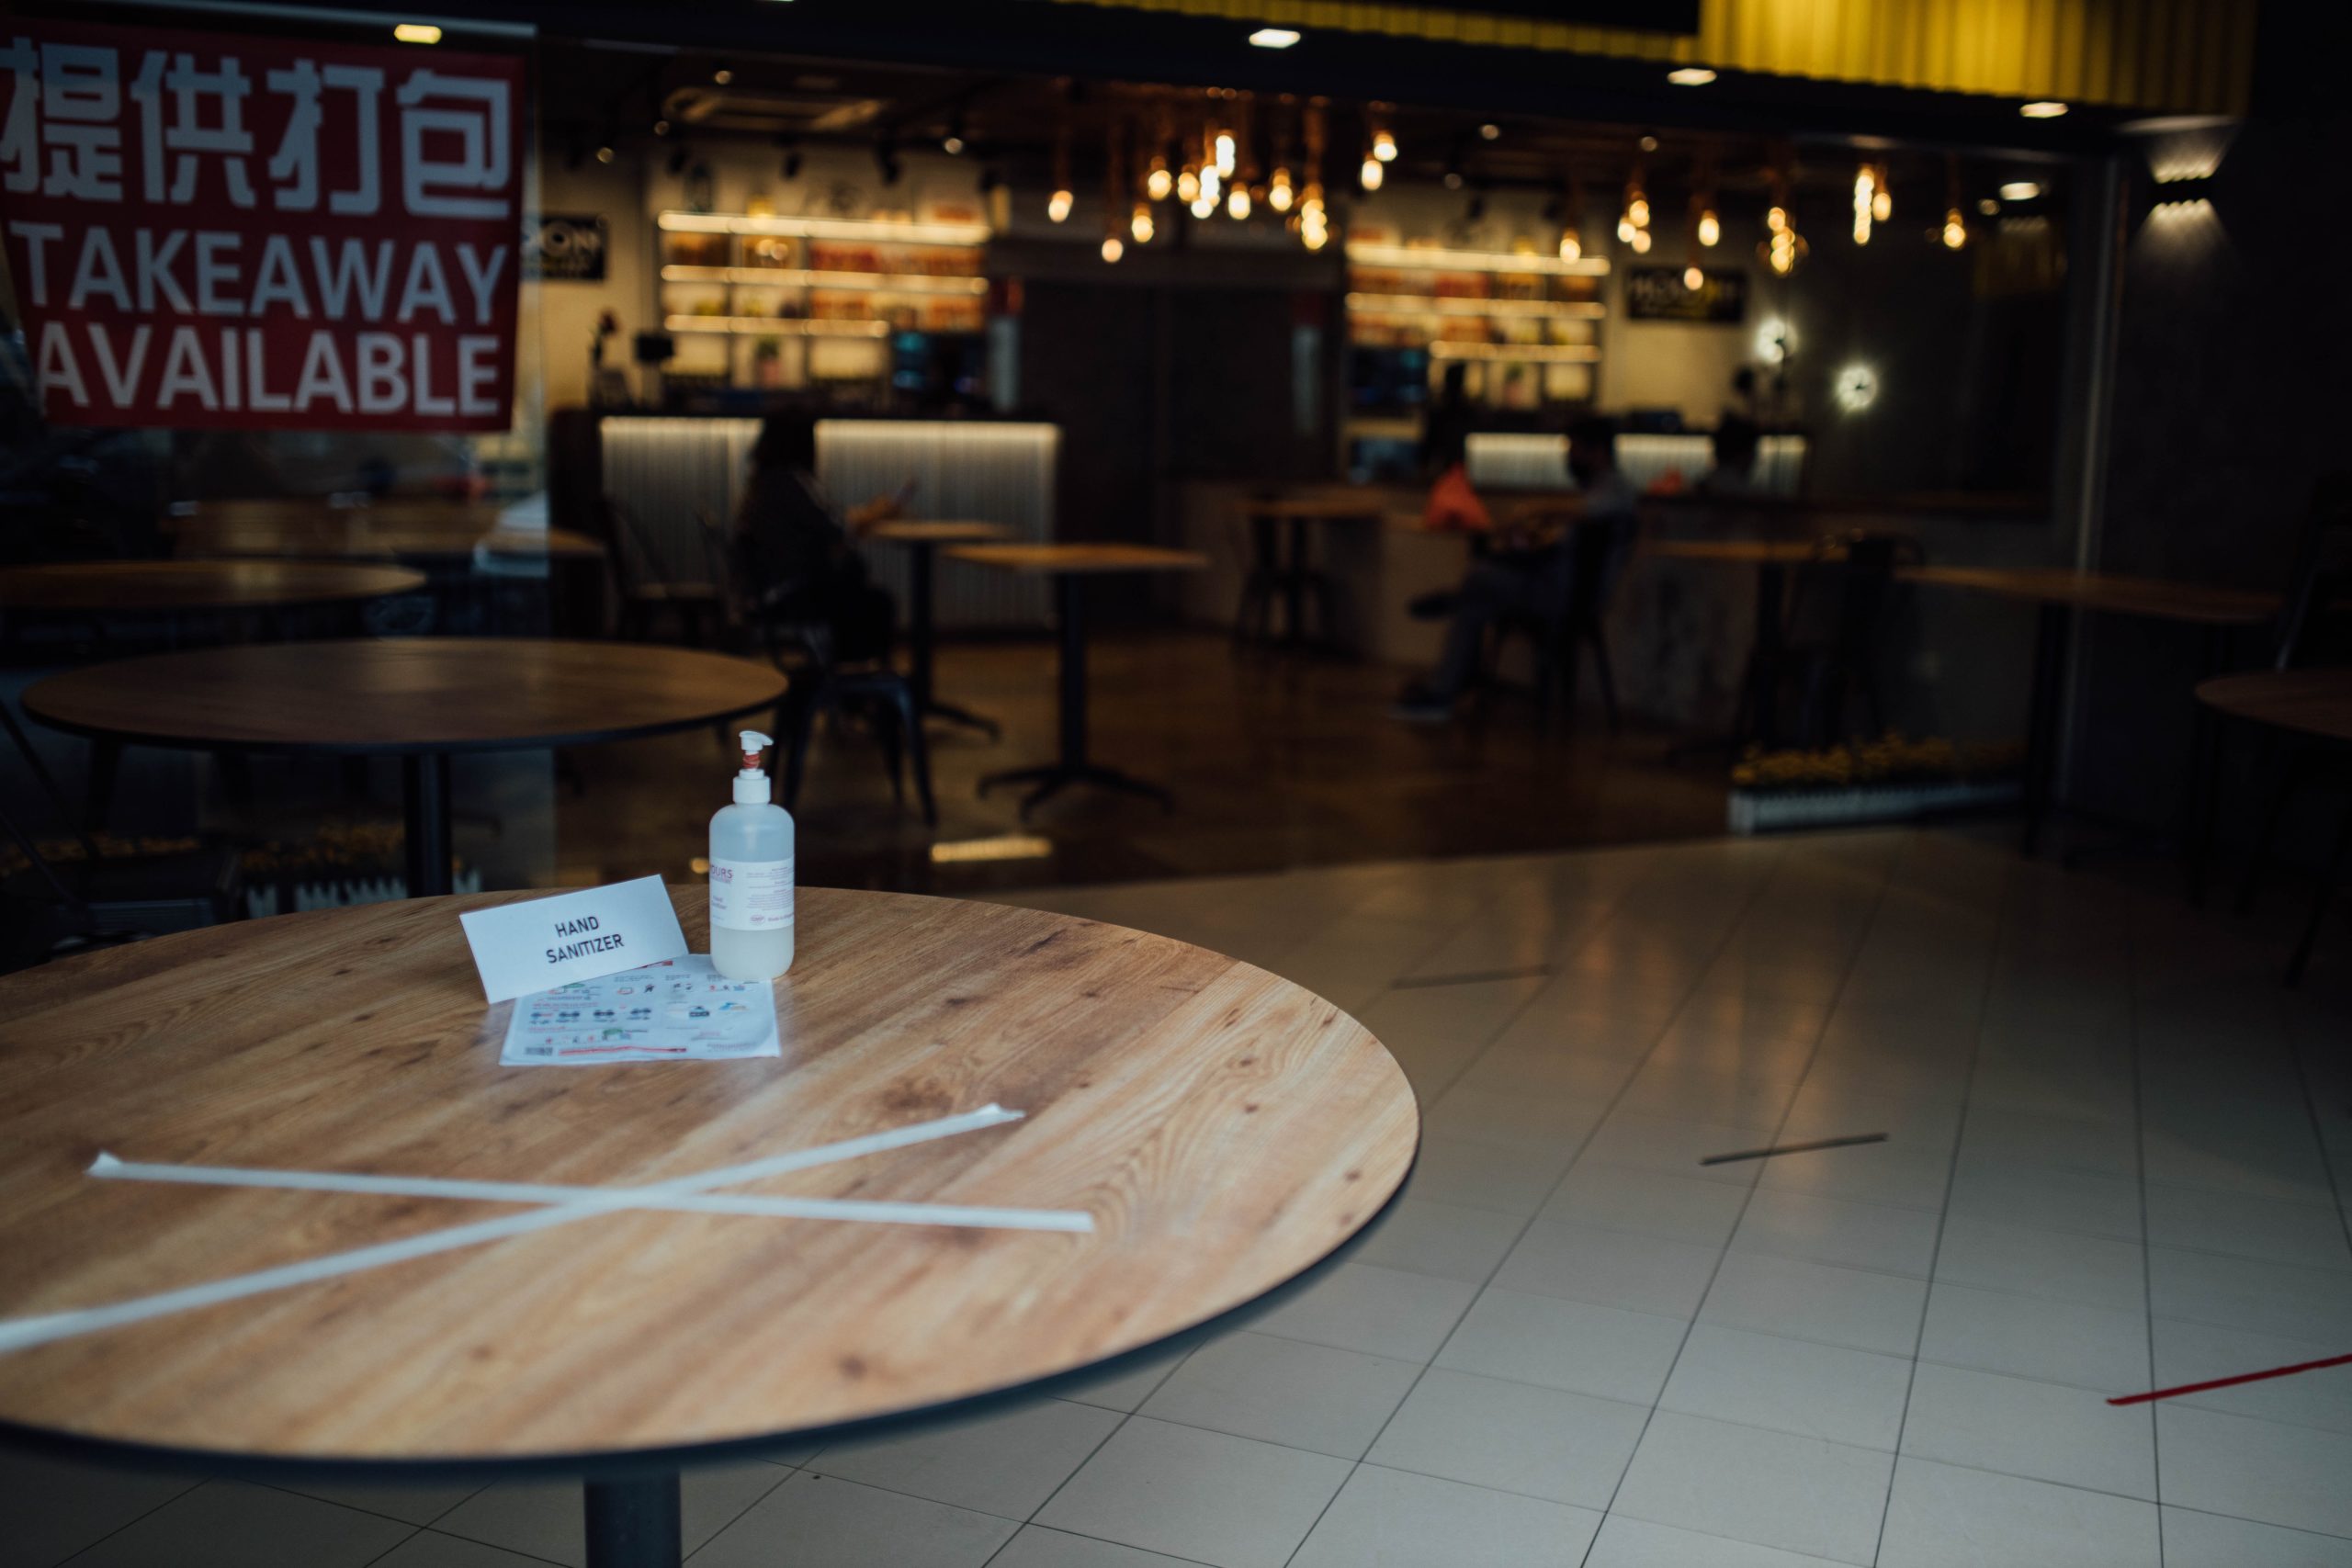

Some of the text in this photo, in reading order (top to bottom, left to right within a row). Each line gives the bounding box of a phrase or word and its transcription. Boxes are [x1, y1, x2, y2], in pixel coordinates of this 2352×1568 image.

[0, 37, 513, 220] 提供打包
[9, 221, 508, 326] TAKEAWAY
[37, 321, 502, 418] AVAILABLE
[546, 933, 624, 964] SANITIZER
[554, 916, 599, 938] HAND
